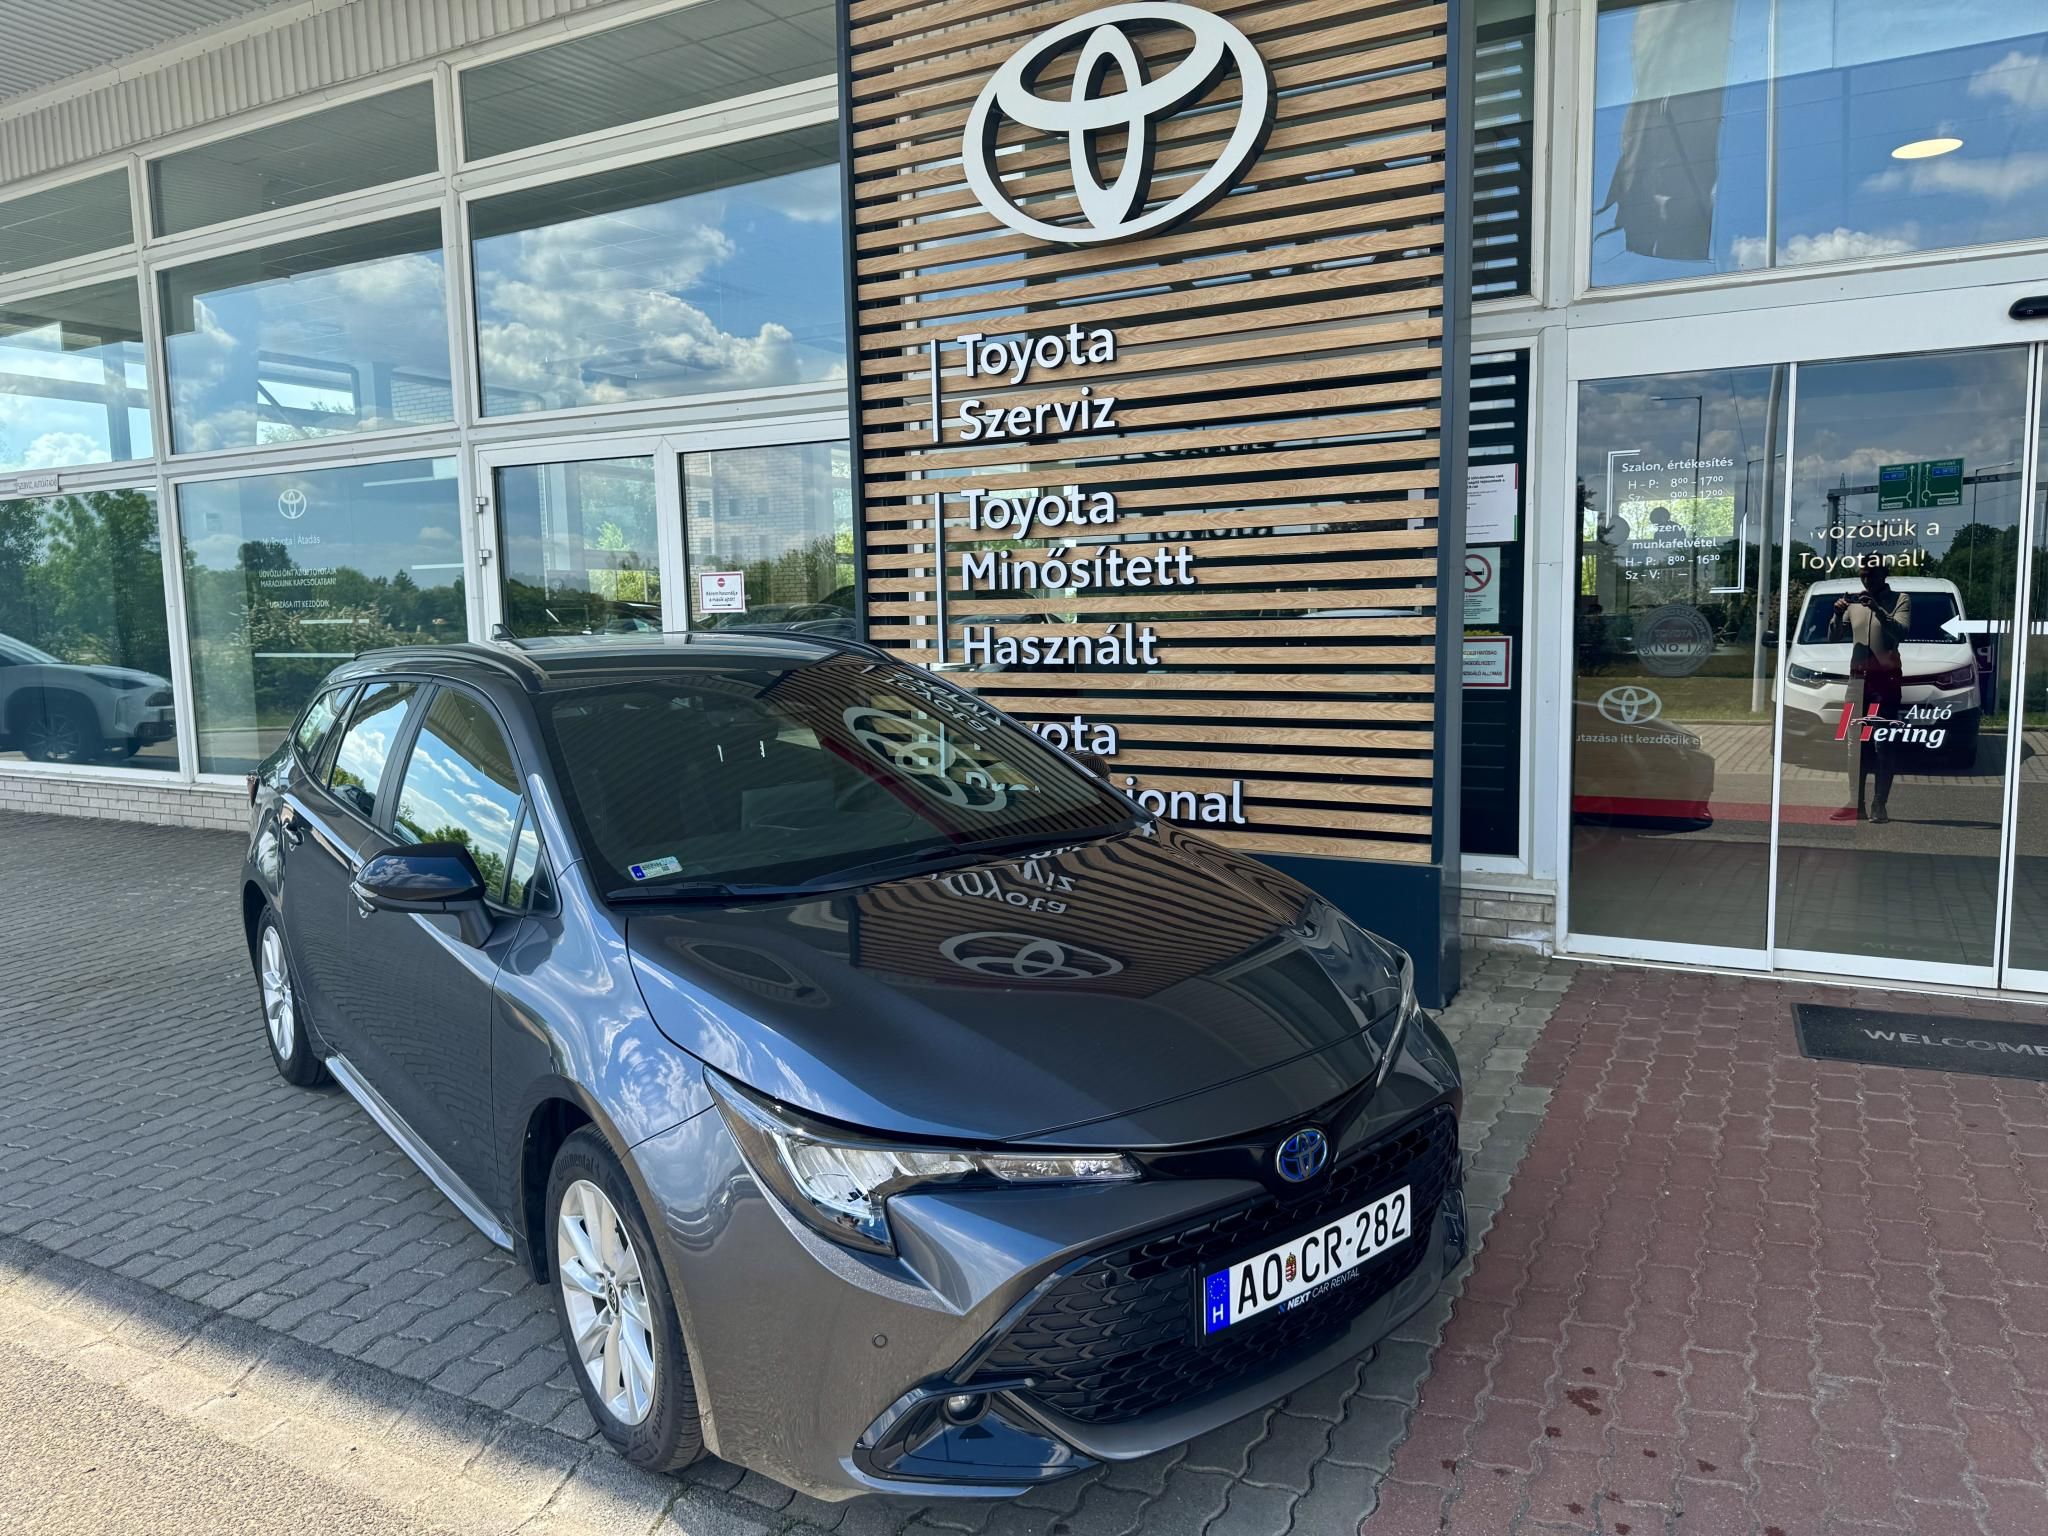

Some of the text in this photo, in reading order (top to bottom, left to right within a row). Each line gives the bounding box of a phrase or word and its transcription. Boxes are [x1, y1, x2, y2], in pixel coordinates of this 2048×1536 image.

[956, 323, 1115, 384] Toyota
[959, 386, 1115, 440] Szerviz
[1622, 457, 1734, 473] Szalon, értékesítés
[960, 485, 1115, 539] Toyota
[1926, 521, 1940, 536] a
[1632, 538, 1718, 550] munkafelvétel
[961, 546, 1196, 591] Minősített
[1797, 548, 1926, 574] Toyotánál!
[963, 623, 1161, 665] Használt
[1904, 704, 1953, 720] Autó
[1620, 733, 1633, 743] itt
[1863, 1028, 2048, 1057] WELCOME
[1237, 1193, 1406, 1314] AO CR-282
[1287, 1267, 1360, 1311] NEXT CAR RENTAL
[1212, 1303, 1224, 1324] H
